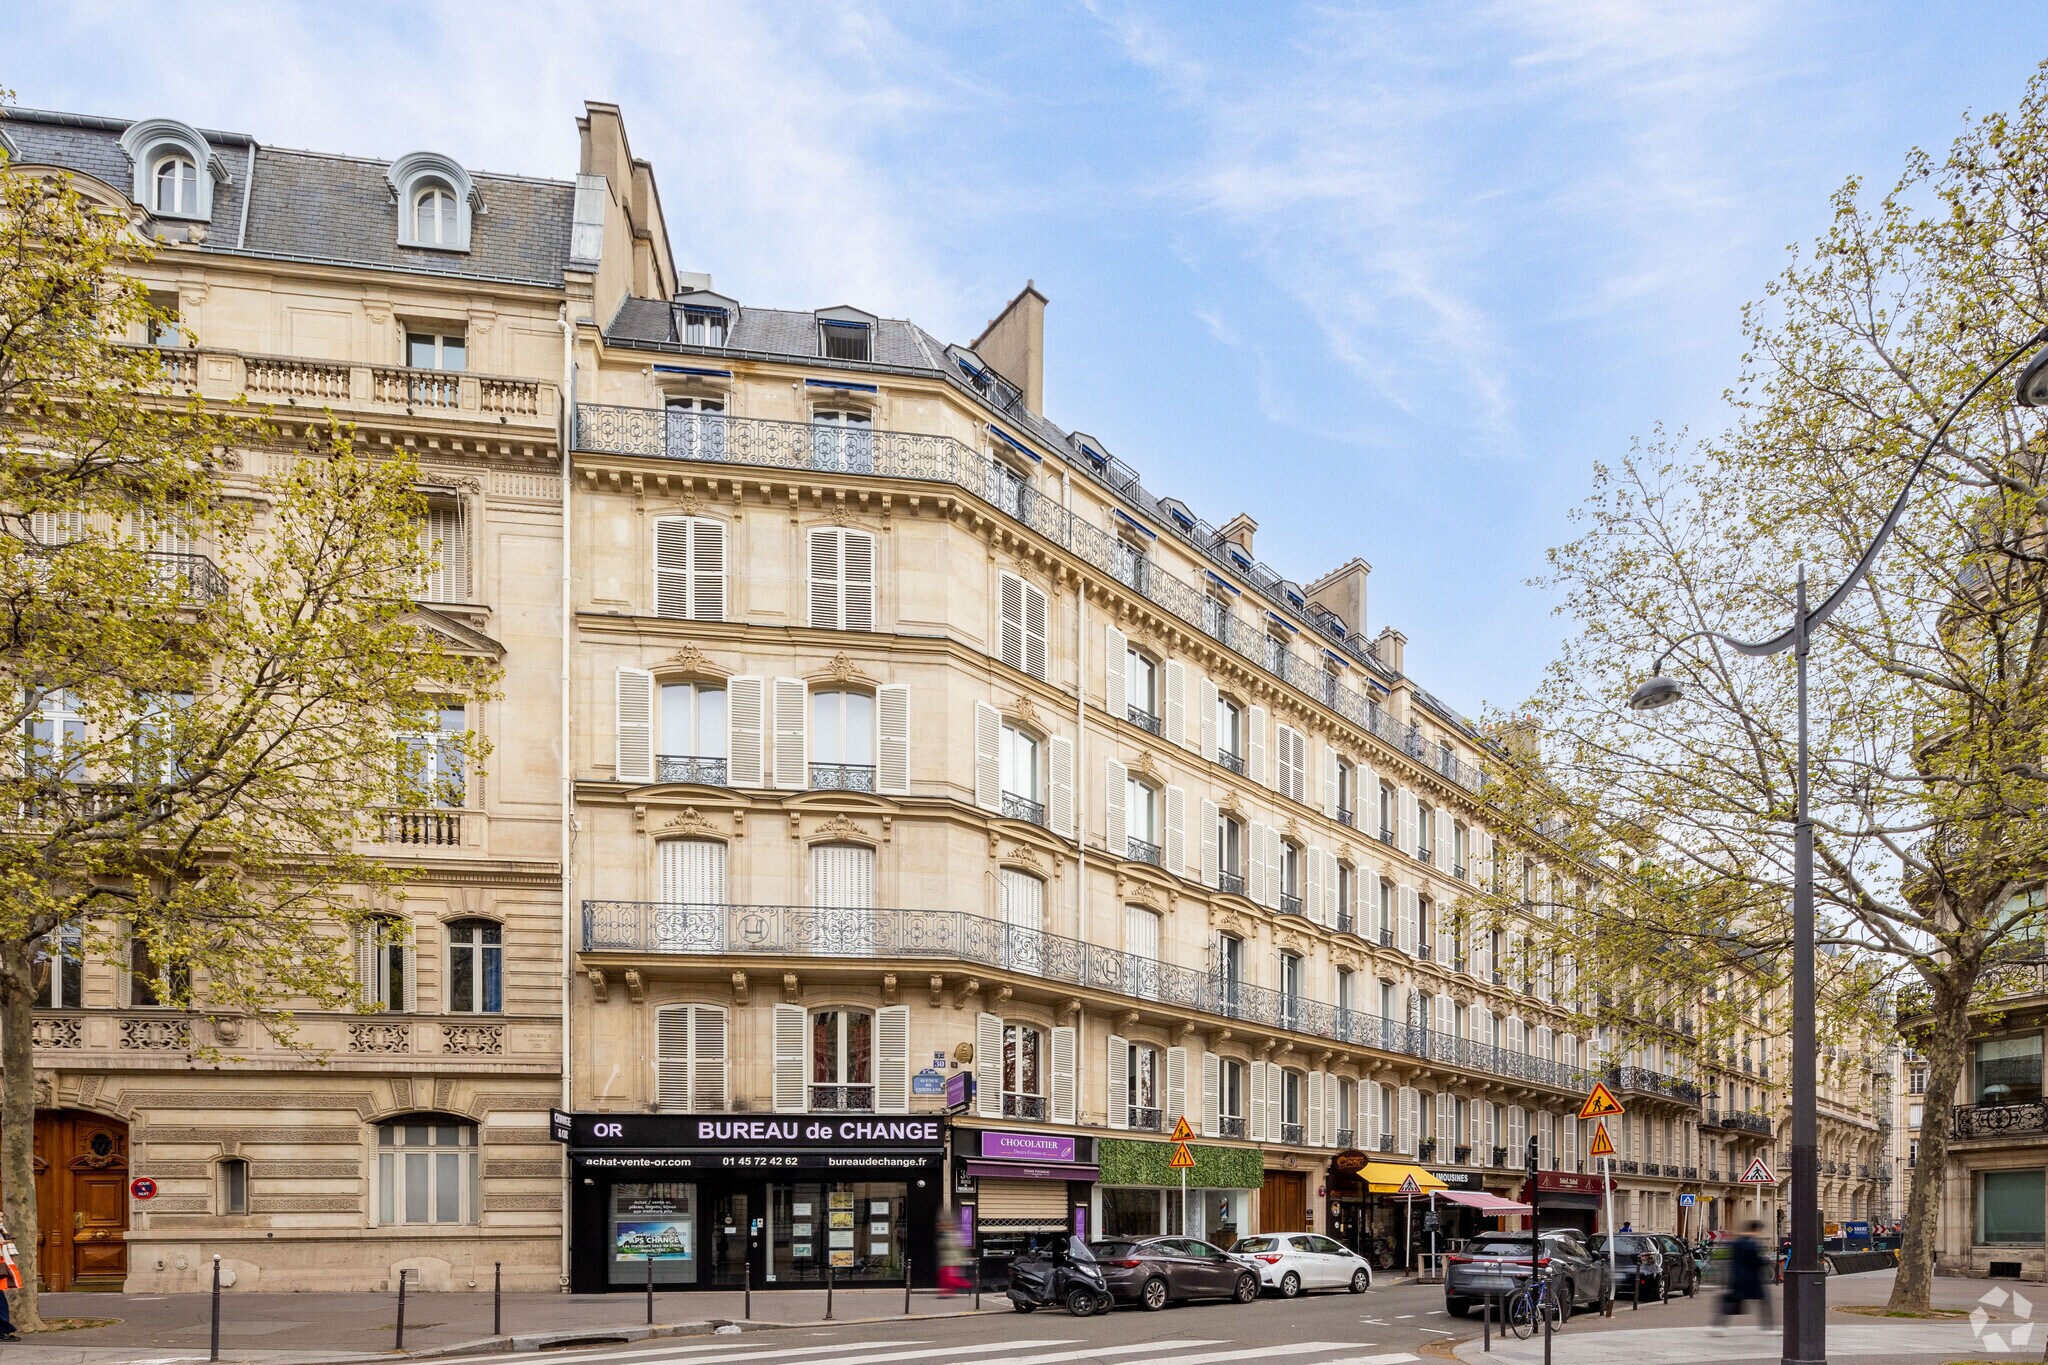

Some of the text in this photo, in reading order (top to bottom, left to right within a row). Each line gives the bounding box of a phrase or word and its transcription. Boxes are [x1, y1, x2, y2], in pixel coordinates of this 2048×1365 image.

[934, 1060, 945, 1068] 30
[554, 1113, 572, 1127] CHANGE
[593, 1122, 938, 1140] OR BUREAU de CHANGE
[1000, 1138, 1058, 1149] CHOCOLATIER
[585, 1158, 691, 1167] achat-vente-or.com
[722, 1157, 798, 1166] 01 45 72 42 62
[828, 1157, 928, 1168] bureaudechange.fr
